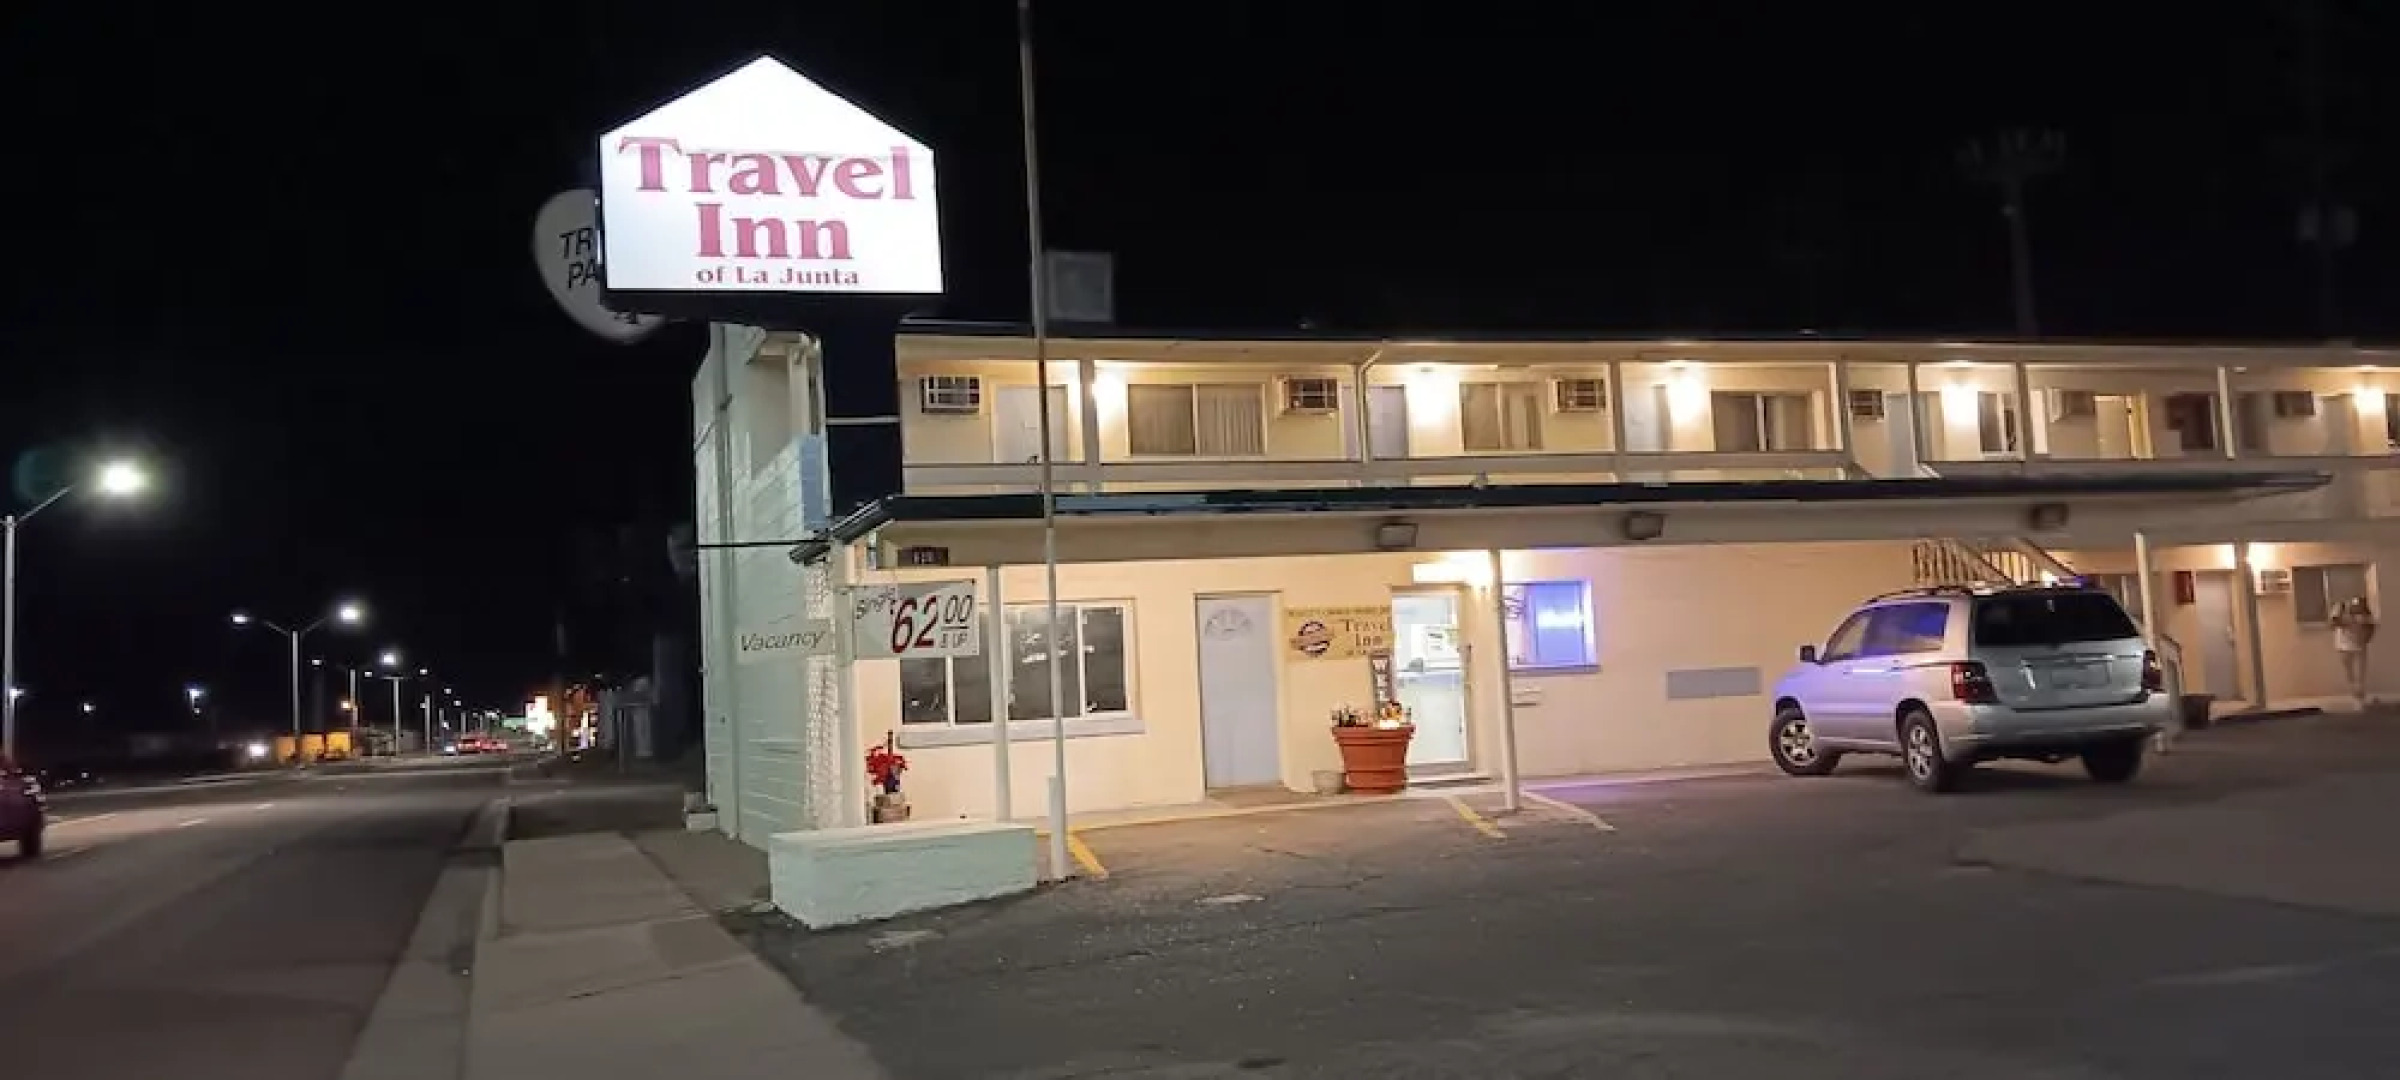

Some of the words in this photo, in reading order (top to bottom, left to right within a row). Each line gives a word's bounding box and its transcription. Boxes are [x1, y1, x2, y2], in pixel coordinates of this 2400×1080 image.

[619, 136, 916, 199] Travel
[559, 227, 593, 259] TR
[694, 202, 853, 259] Inn
[568, 259, 597, 288] PA
[696, 266, 725, 283] of
[736, 266, 769, 283] La
[780, 268, 859, 285] Junta
[892, 595, 938, 653] 62
[944, 594, 973, 624] 00
[741, 631, 826, 652] Vacancy
